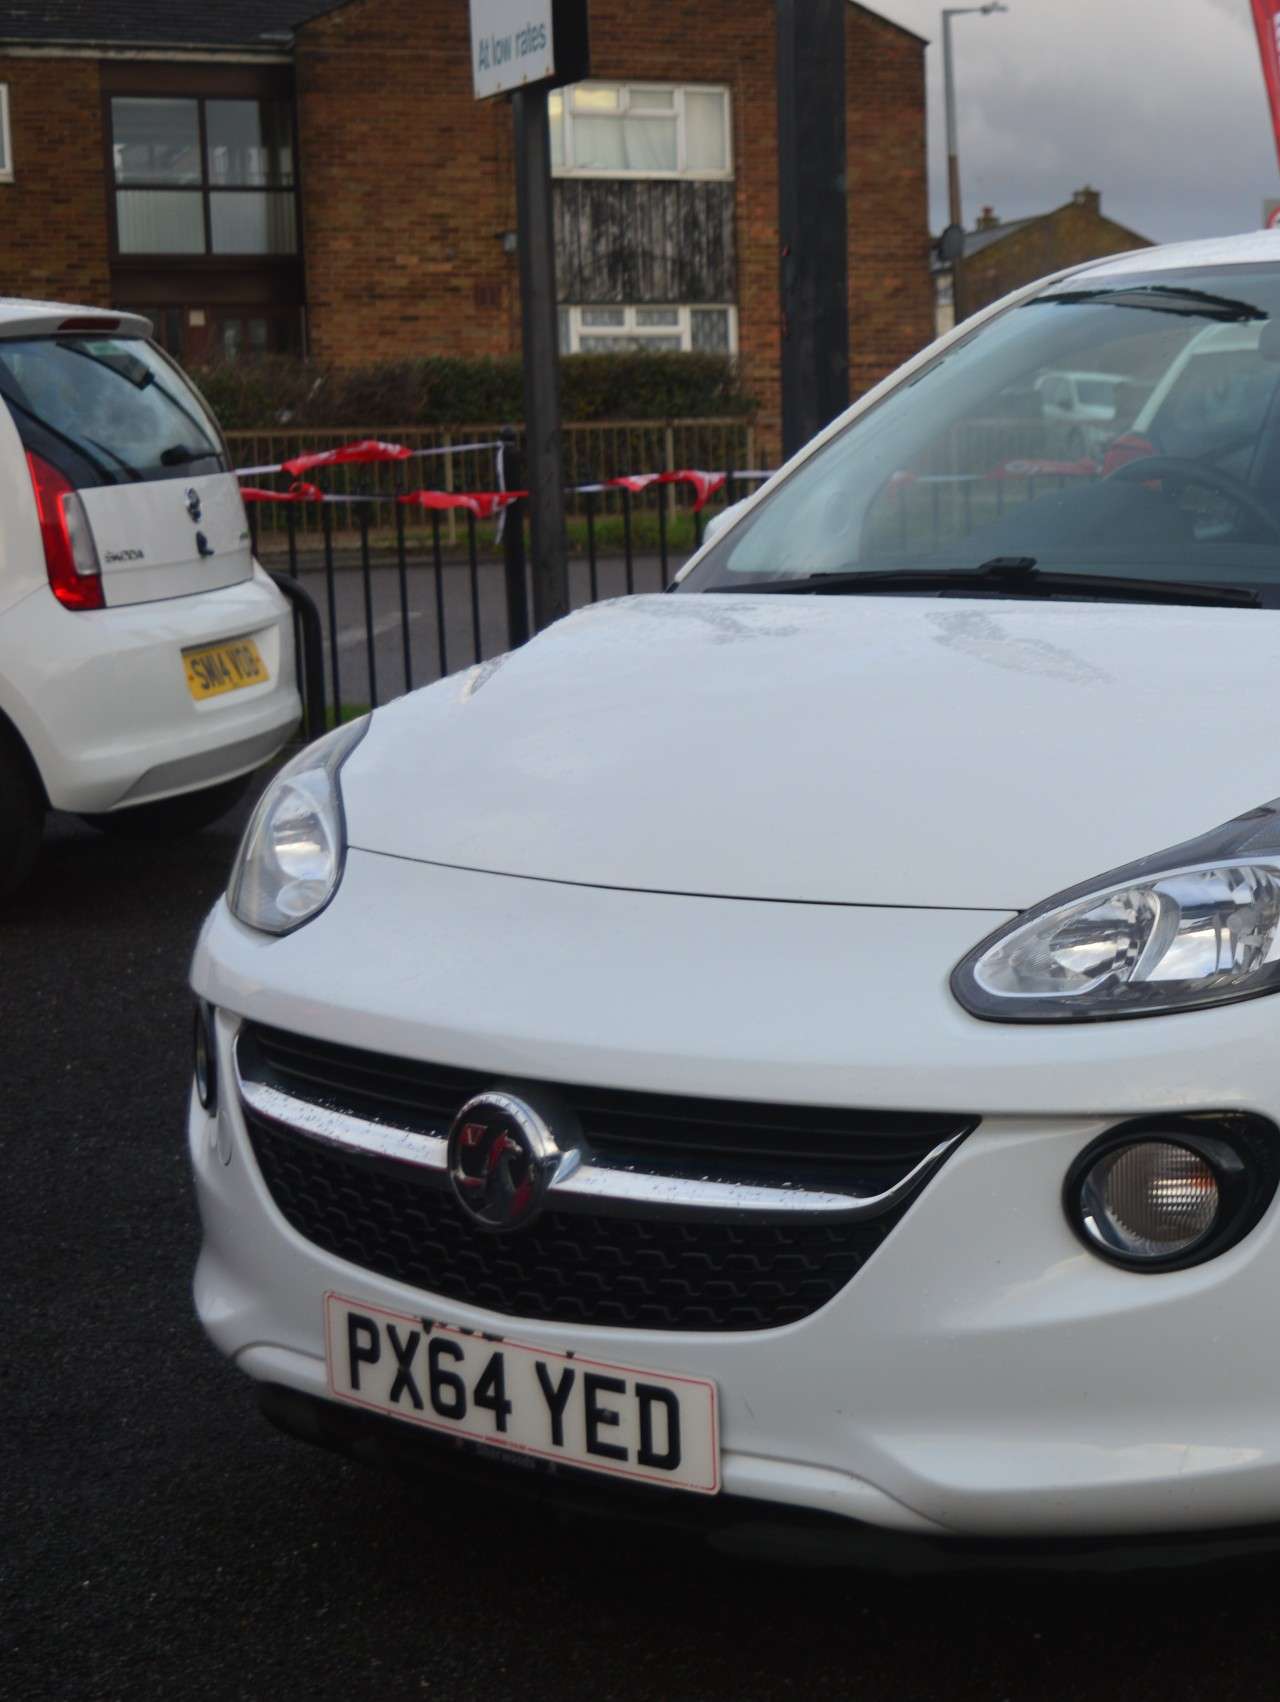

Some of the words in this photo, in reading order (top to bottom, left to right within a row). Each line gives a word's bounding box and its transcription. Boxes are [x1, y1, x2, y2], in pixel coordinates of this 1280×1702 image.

[492, 33, 512, 67] low
[515, 21, 547, 60] rates
[346, 1311, 513, 1433] PX64
[535, 1360, 683, 1472] YED
